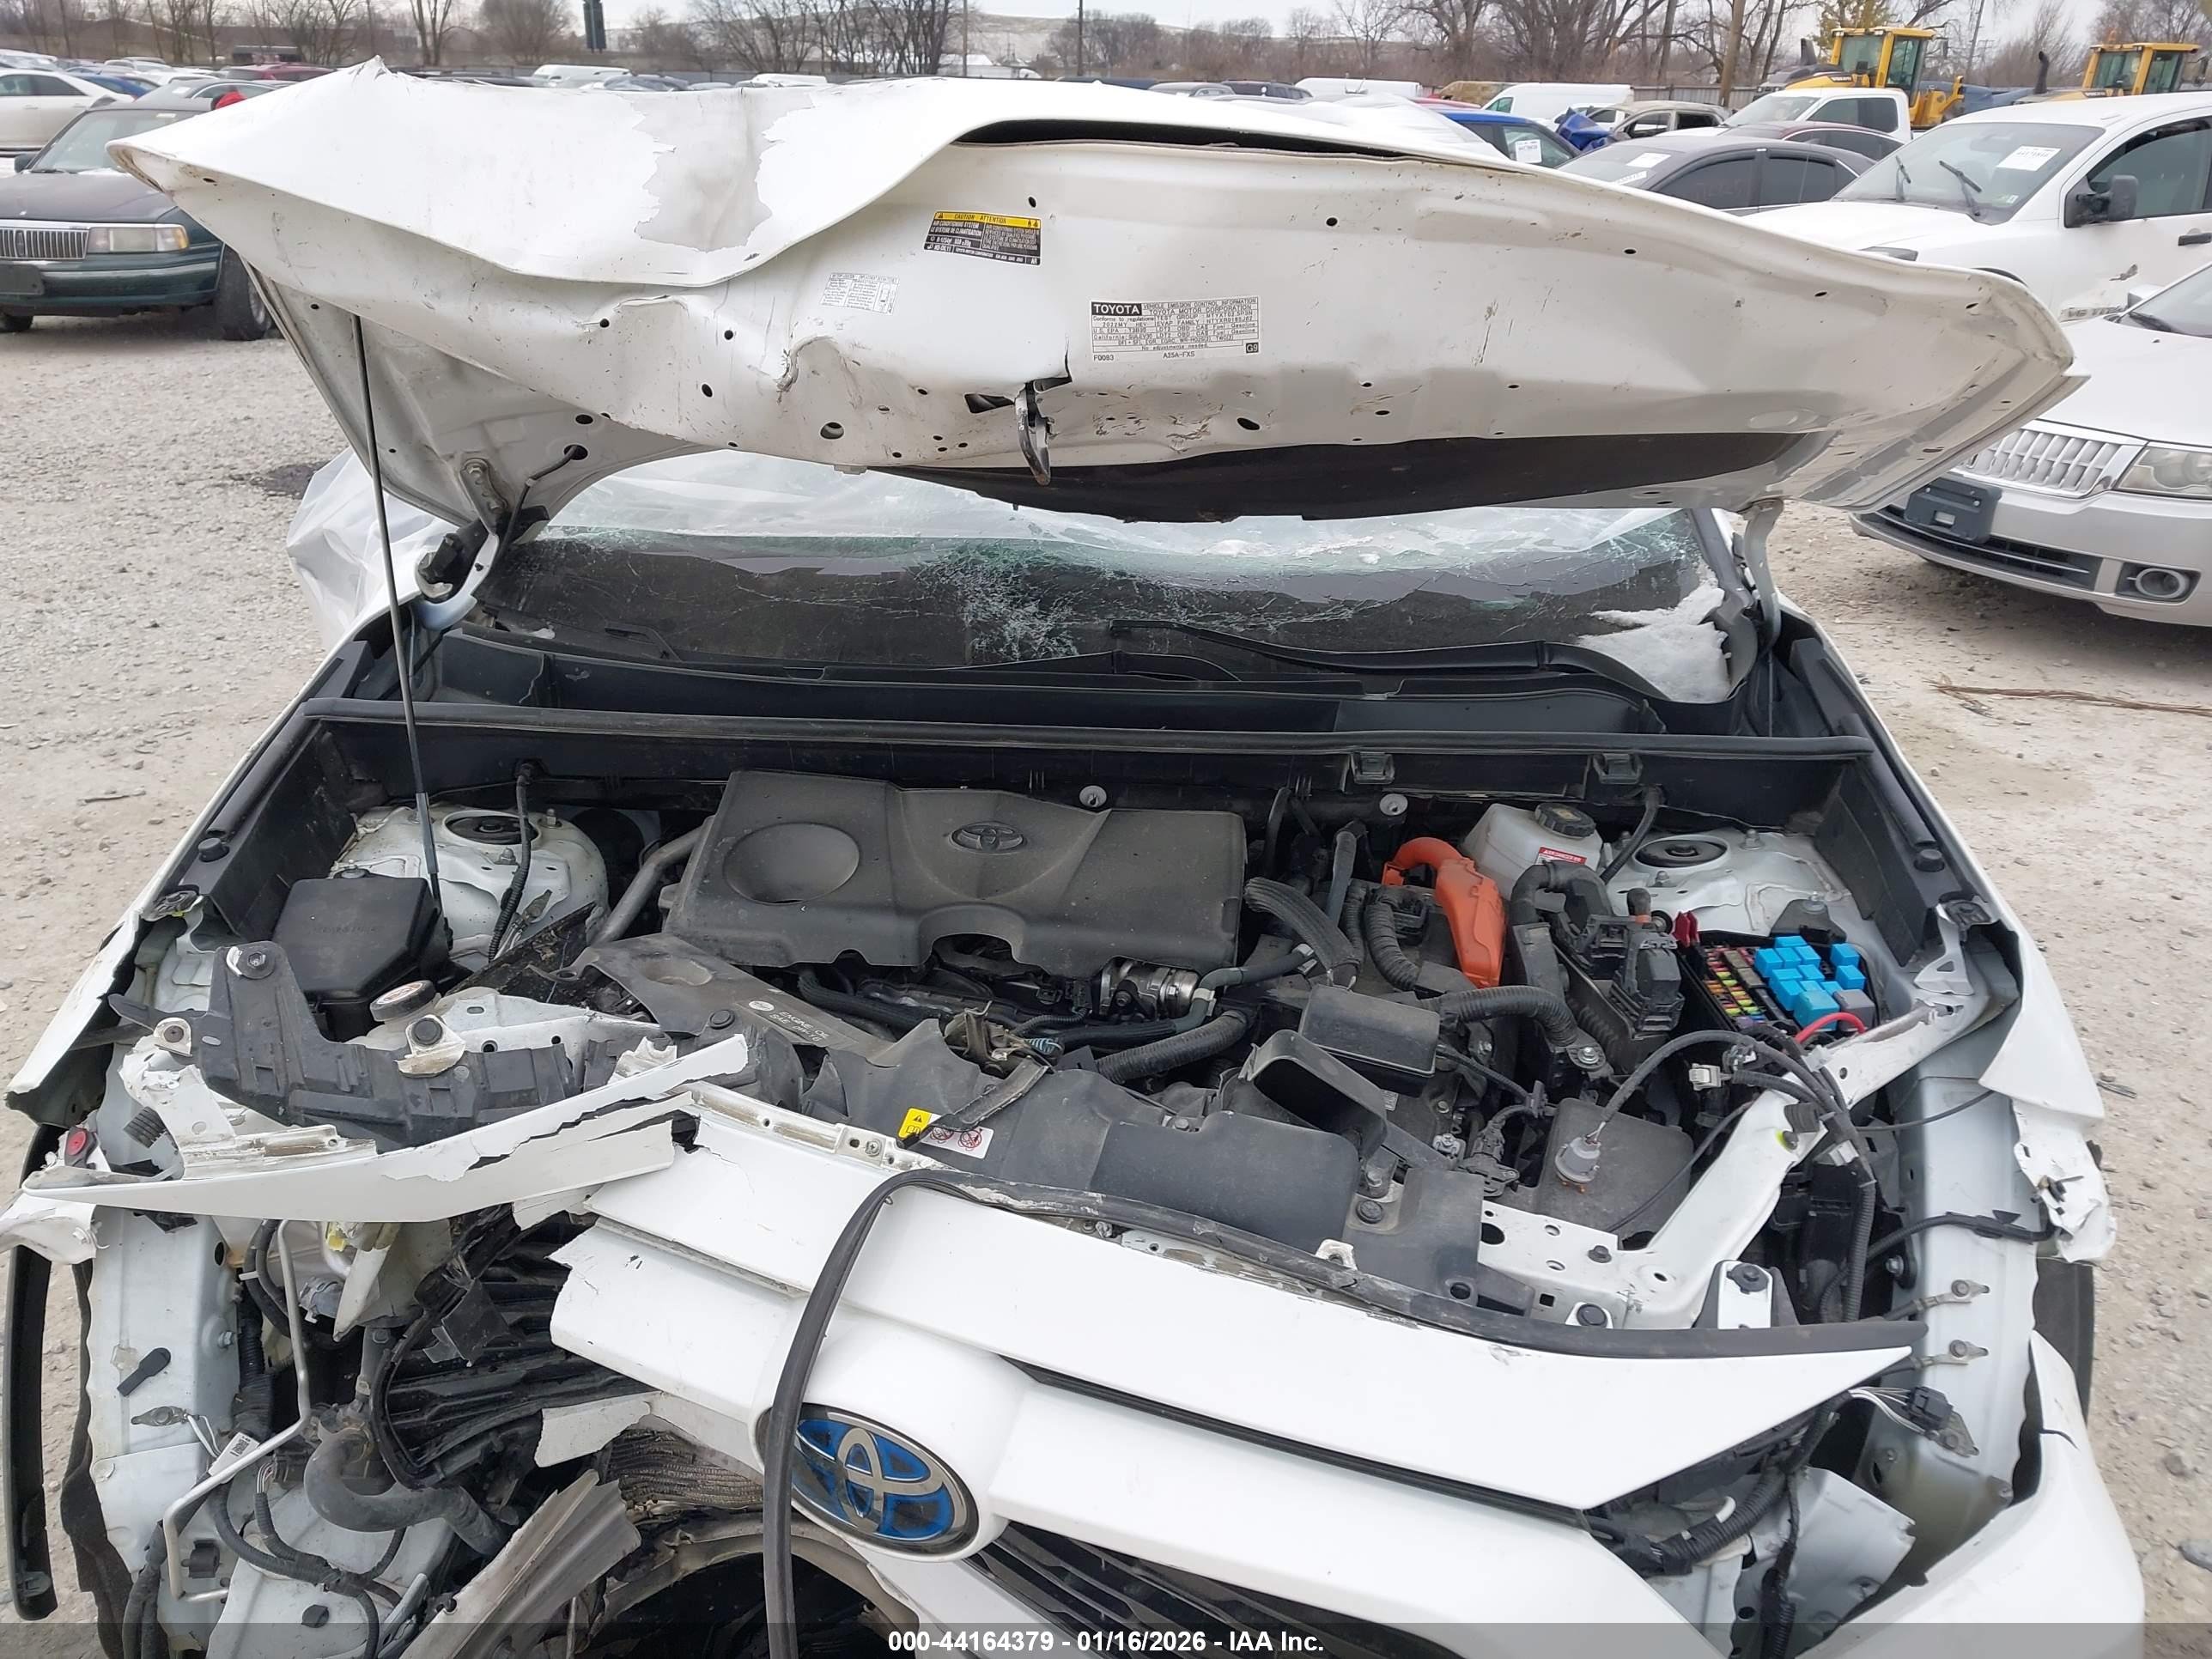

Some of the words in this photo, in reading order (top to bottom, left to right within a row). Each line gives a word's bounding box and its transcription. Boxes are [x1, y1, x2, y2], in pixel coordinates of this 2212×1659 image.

[979, 215, 1006, 223] ATTENTION
[1093, 304, 1139, 314] TOYOTA
[1247, 343, 1258, 352] G9
[769, 1013, 791, 1024] SAE
[778, 1012, 814, 1029] ENGINE
